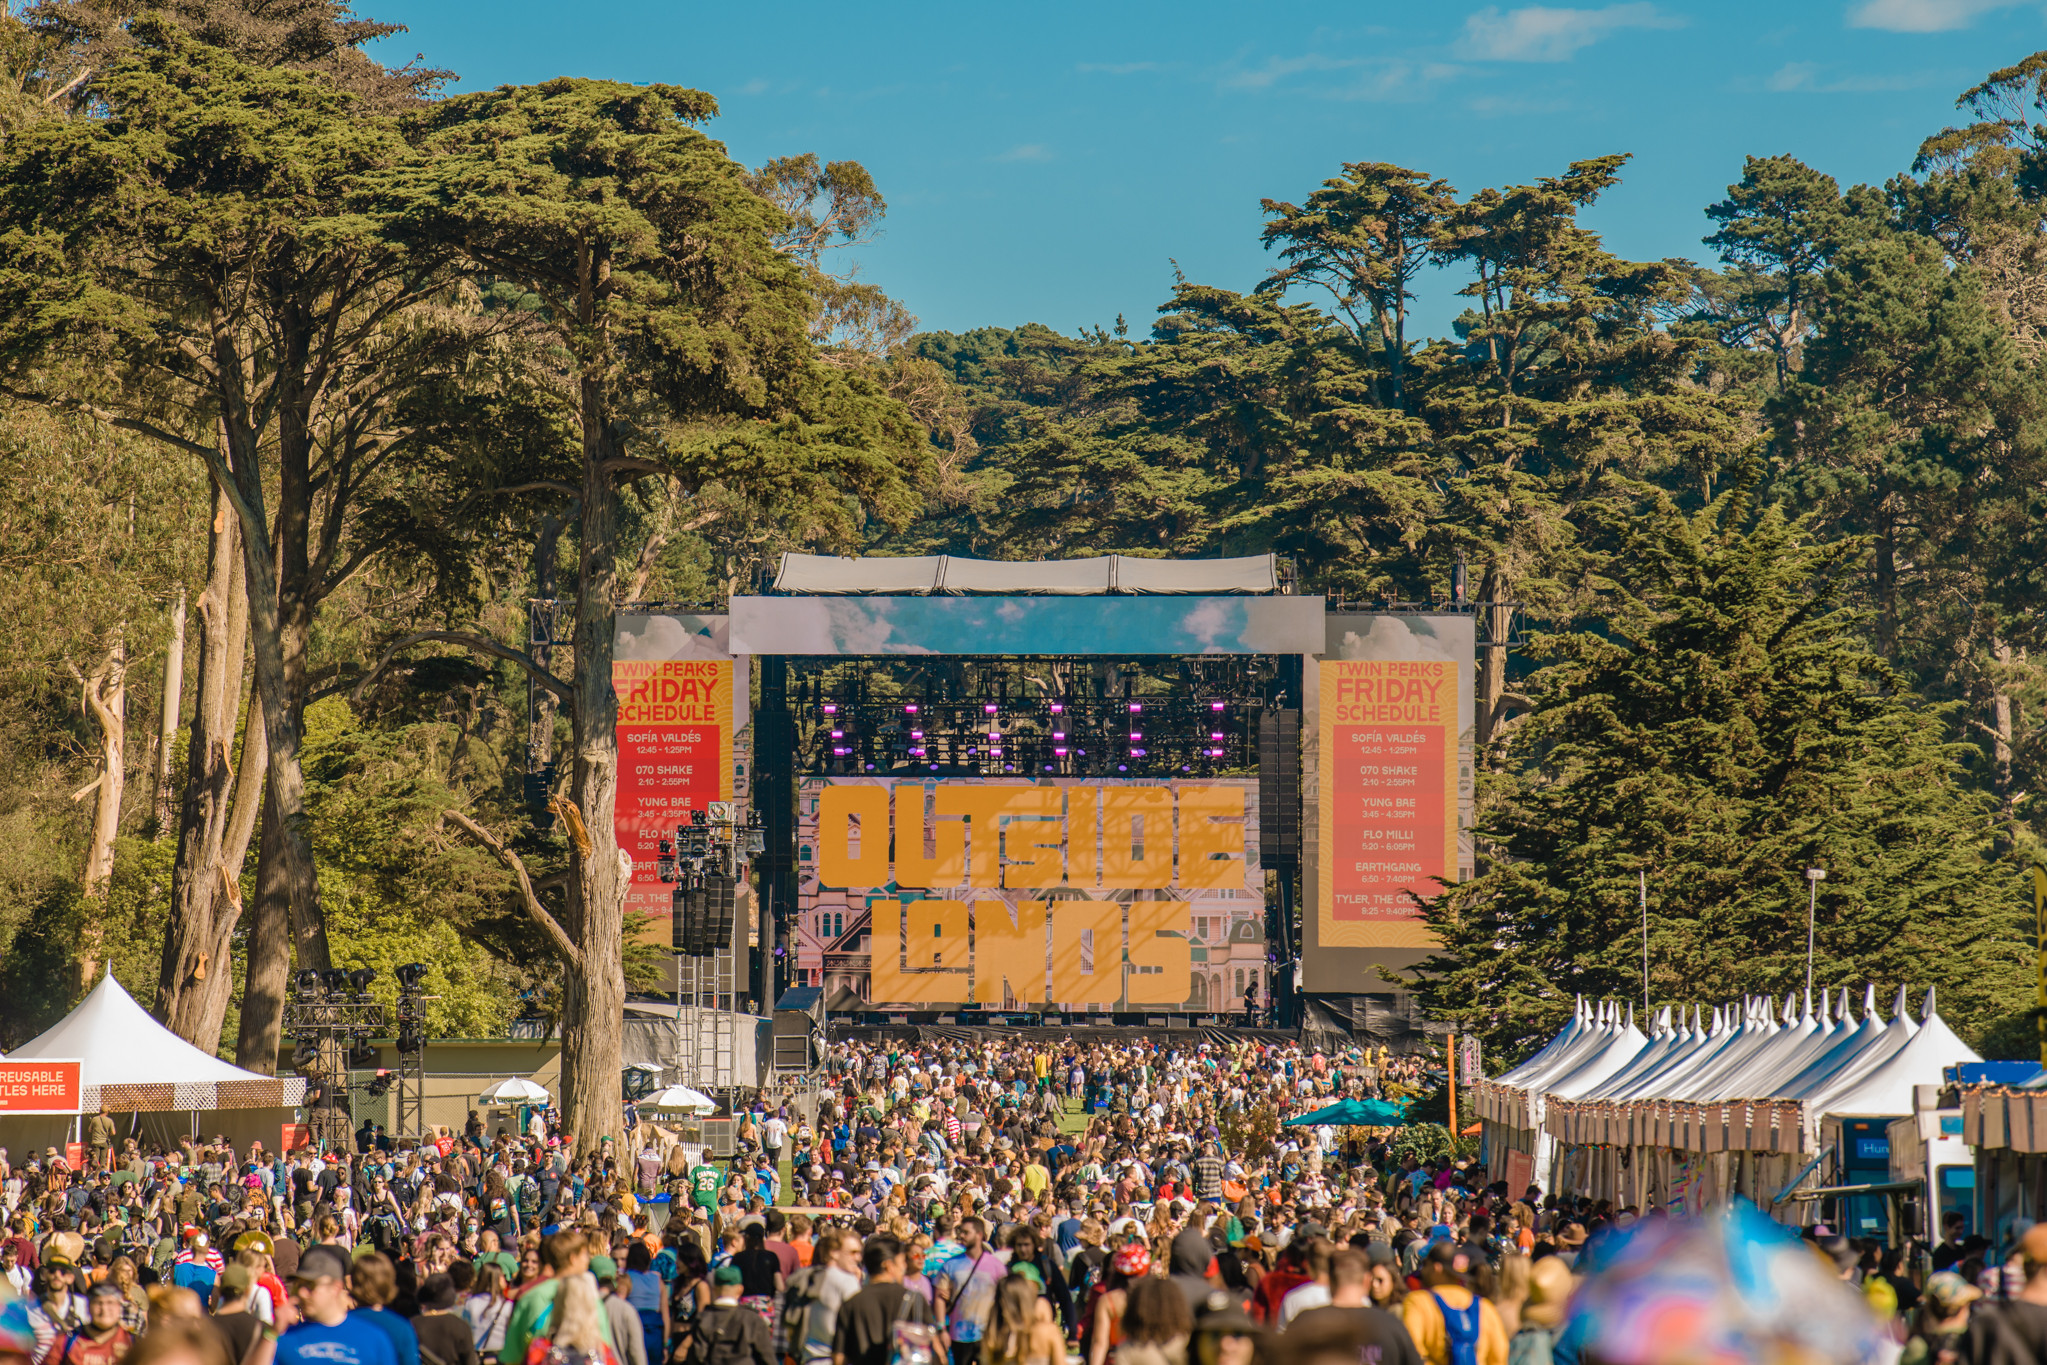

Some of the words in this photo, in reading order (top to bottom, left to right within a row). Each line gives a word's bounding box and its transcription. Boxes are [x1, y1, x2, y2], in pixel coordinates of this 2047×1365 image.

[612, 662, 657, 677] TWIN
[663, 662, 719, 677] PEAKS
[1336, 662, 1382, 677] TWIN
[1388, 662, 1444, 677] PEAKS
[612, 678, 719, 704] FRIDAY
[1336, 678, 1444, 704] FRIDAY
[617, 704, 715, 722] SCHEDULE
[1335, 704, 1441, 722] SCHEDULE
[626, 729, 658, 743] SOFÍA
[661, 729, 702, 743] VALDÉS
[1351, 729, 1383, 743] SOFÍA
[1385, 729, 1427, 744] VALDÉS
[636, 746, 657, 754] 12:45
[664, 746, 692, 754] 1:25PM
[1360, 746, 1382, 754] 12:45
[1389, 746, 1417, 754] 1:25PM
[657, 765, 693, 775] SHAKE
[1381, 765, 1418, 775] SHAKE
[638, 778, 654, 786] 2:10
[661, 778, 690, 786] 2:55PM
[1362, 778, 1379, 786] 2:10
[1386, 778, 1415, 786] 2:55PM
[637, 797, 668, 807] YUNG
[671, 797, 691, 807] BAE
[1362, 798, 1393, 807] YUNG
[1395, 798, 1416, 807] BAE
[637, 810, 655, 818] 3:45
[661, 810, 690, 818] 4:35PM
[1362, 810, 1379, 818] 3:45
[1385, 810, 1415, 818] 4:35PM
[639, 829, 658, 839] FLO
[819, 786, 1245, 889] OUTSIDE
[1363, 830, 1383, 839] FLO
[1386, 830, 1414, 839] MILLI
[637, 842, 654, 850] 5:20
[1361, 842, 1379, 850] 5:20
[1385, 842, 1415, 850] 6:05PM
[1355, 862, 1422, 872] EARTHGANG
[637, 874, 654, 882] 6:50
[1361, 875, 1379, 883] 6:50
[1386, 875, 1415, 883] 7:40PM
[648, 893, 669, 903] THE
[1335, 894, 1371, 905] TYLER,
[1373, 894, 1393, 904] THE
[871, 899, 1192, 1004] LANDS
[0, 1071, 64, 1083] REUSABLE
[32, 1084, 66, 1096] HERE
[1863, 1142, 1890, 1154] Hun
[698, 1177, 715, 1191] 26
